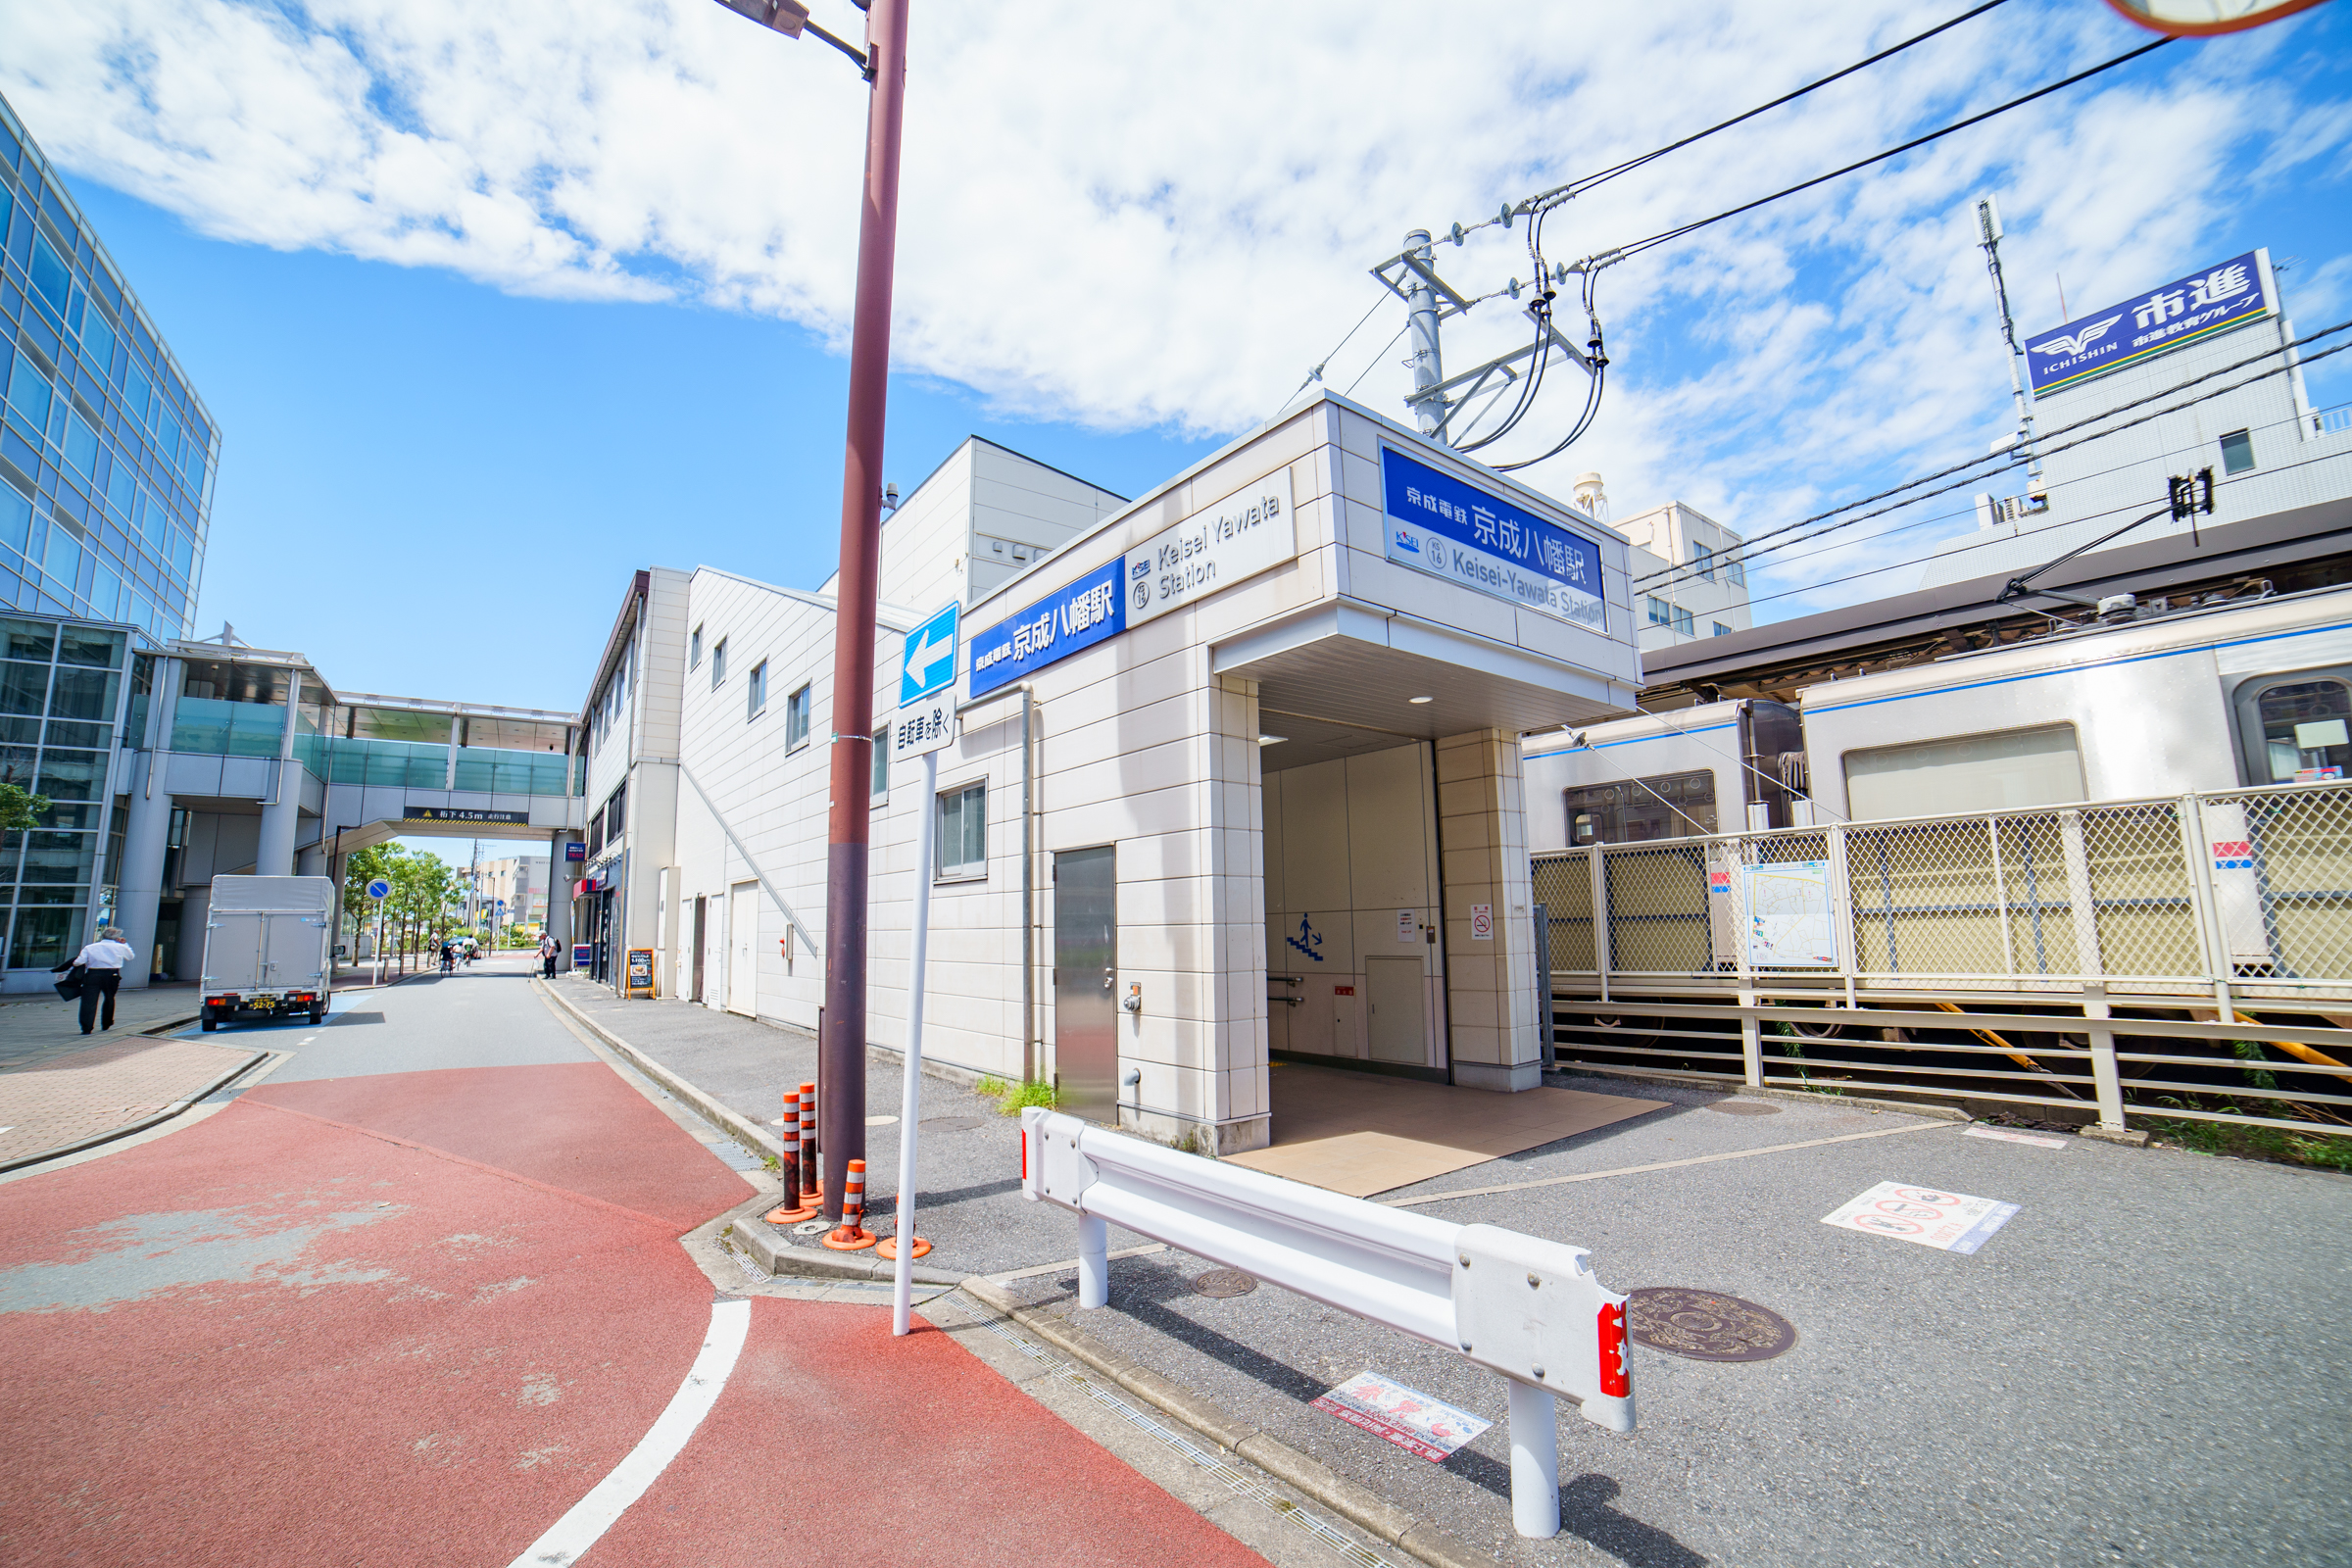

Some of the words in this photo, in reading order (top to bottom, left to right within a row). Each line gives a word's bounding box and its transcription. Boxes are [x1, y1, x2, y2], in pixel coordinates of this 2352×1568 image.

[2131, 262, 2252, 330] 市進
[2132, 291, 2260, 348] 市進教育グループ
[2043, 341, 2119, 375] ICHISHIN
[1158, 524, 1208, 570] Keisei
[1210, 493, 1280, 544] Yawata
[1405, 485, 1468, 526] 京成電鉄
[1471, 503, 1588, 585] 京成八幡駅
[1431, 540, 1441, 552] KS
[1158, 557, 1216, 600] Station
[1431, 551, 1443, 564] 16
[1136, 592, 1147, 605] 16
[1452, 549, 1557, 607] Keisei-Yawata
[1560, 591, 1603, 625] Station
[975, 641, 1012, 673] 京成電鉄
[1011, 579, 1115, 662] 京成八幡駅
[898, 707, 949, 751] 自転車を除く
[439, 809, 457, 819] 桁下
[459, 811, 483, 820] 4.5m
